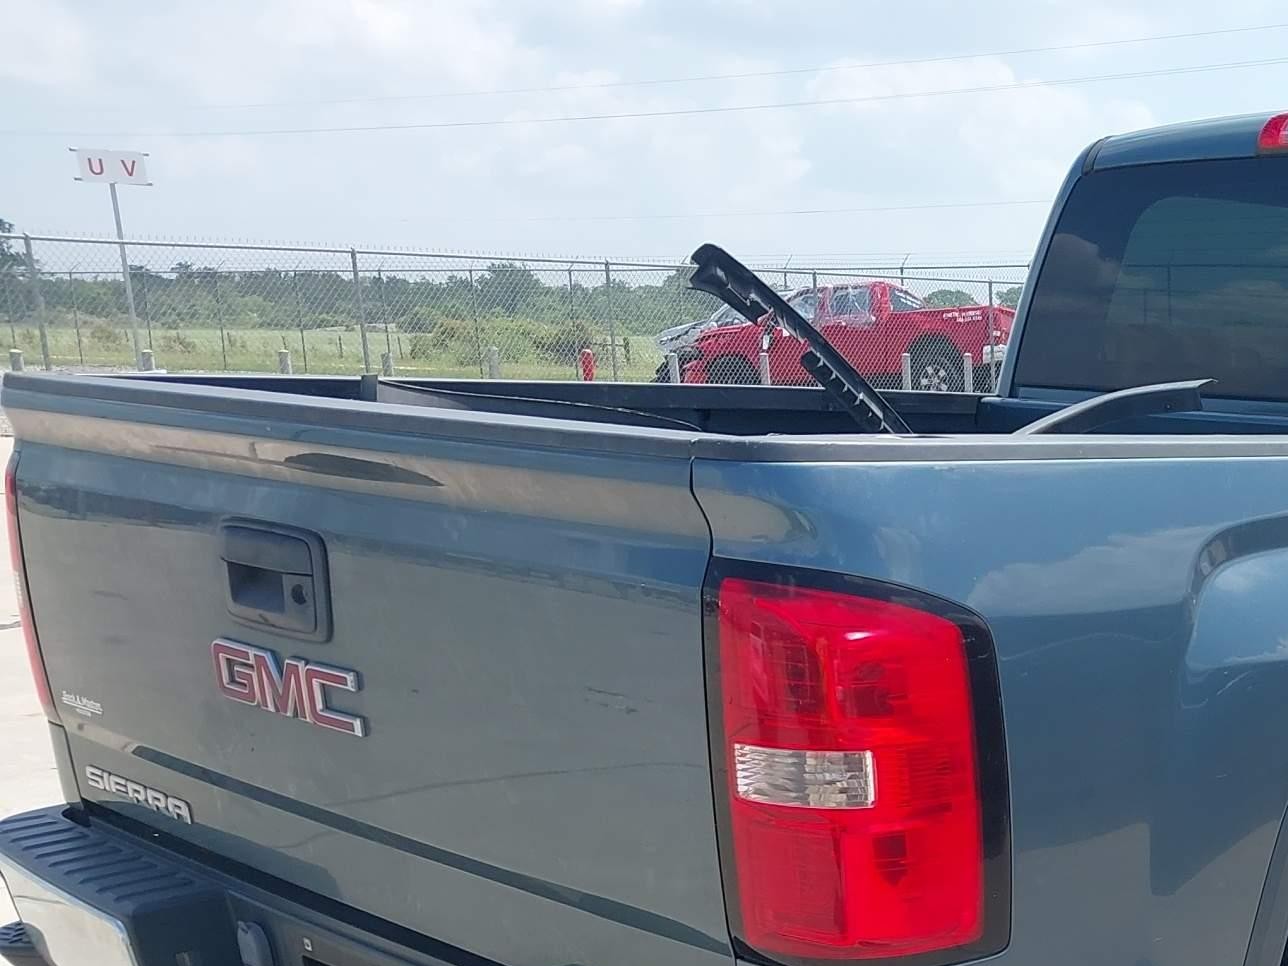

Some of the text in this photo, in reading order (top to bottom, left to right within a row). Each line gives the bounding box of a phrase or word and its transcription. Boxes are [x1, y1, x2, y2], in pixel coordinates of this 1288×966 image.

[87, 157, 136, 177] U V
[211, 637, 367, 738] GMC
[85, 766, 193, 825] SIERRA
